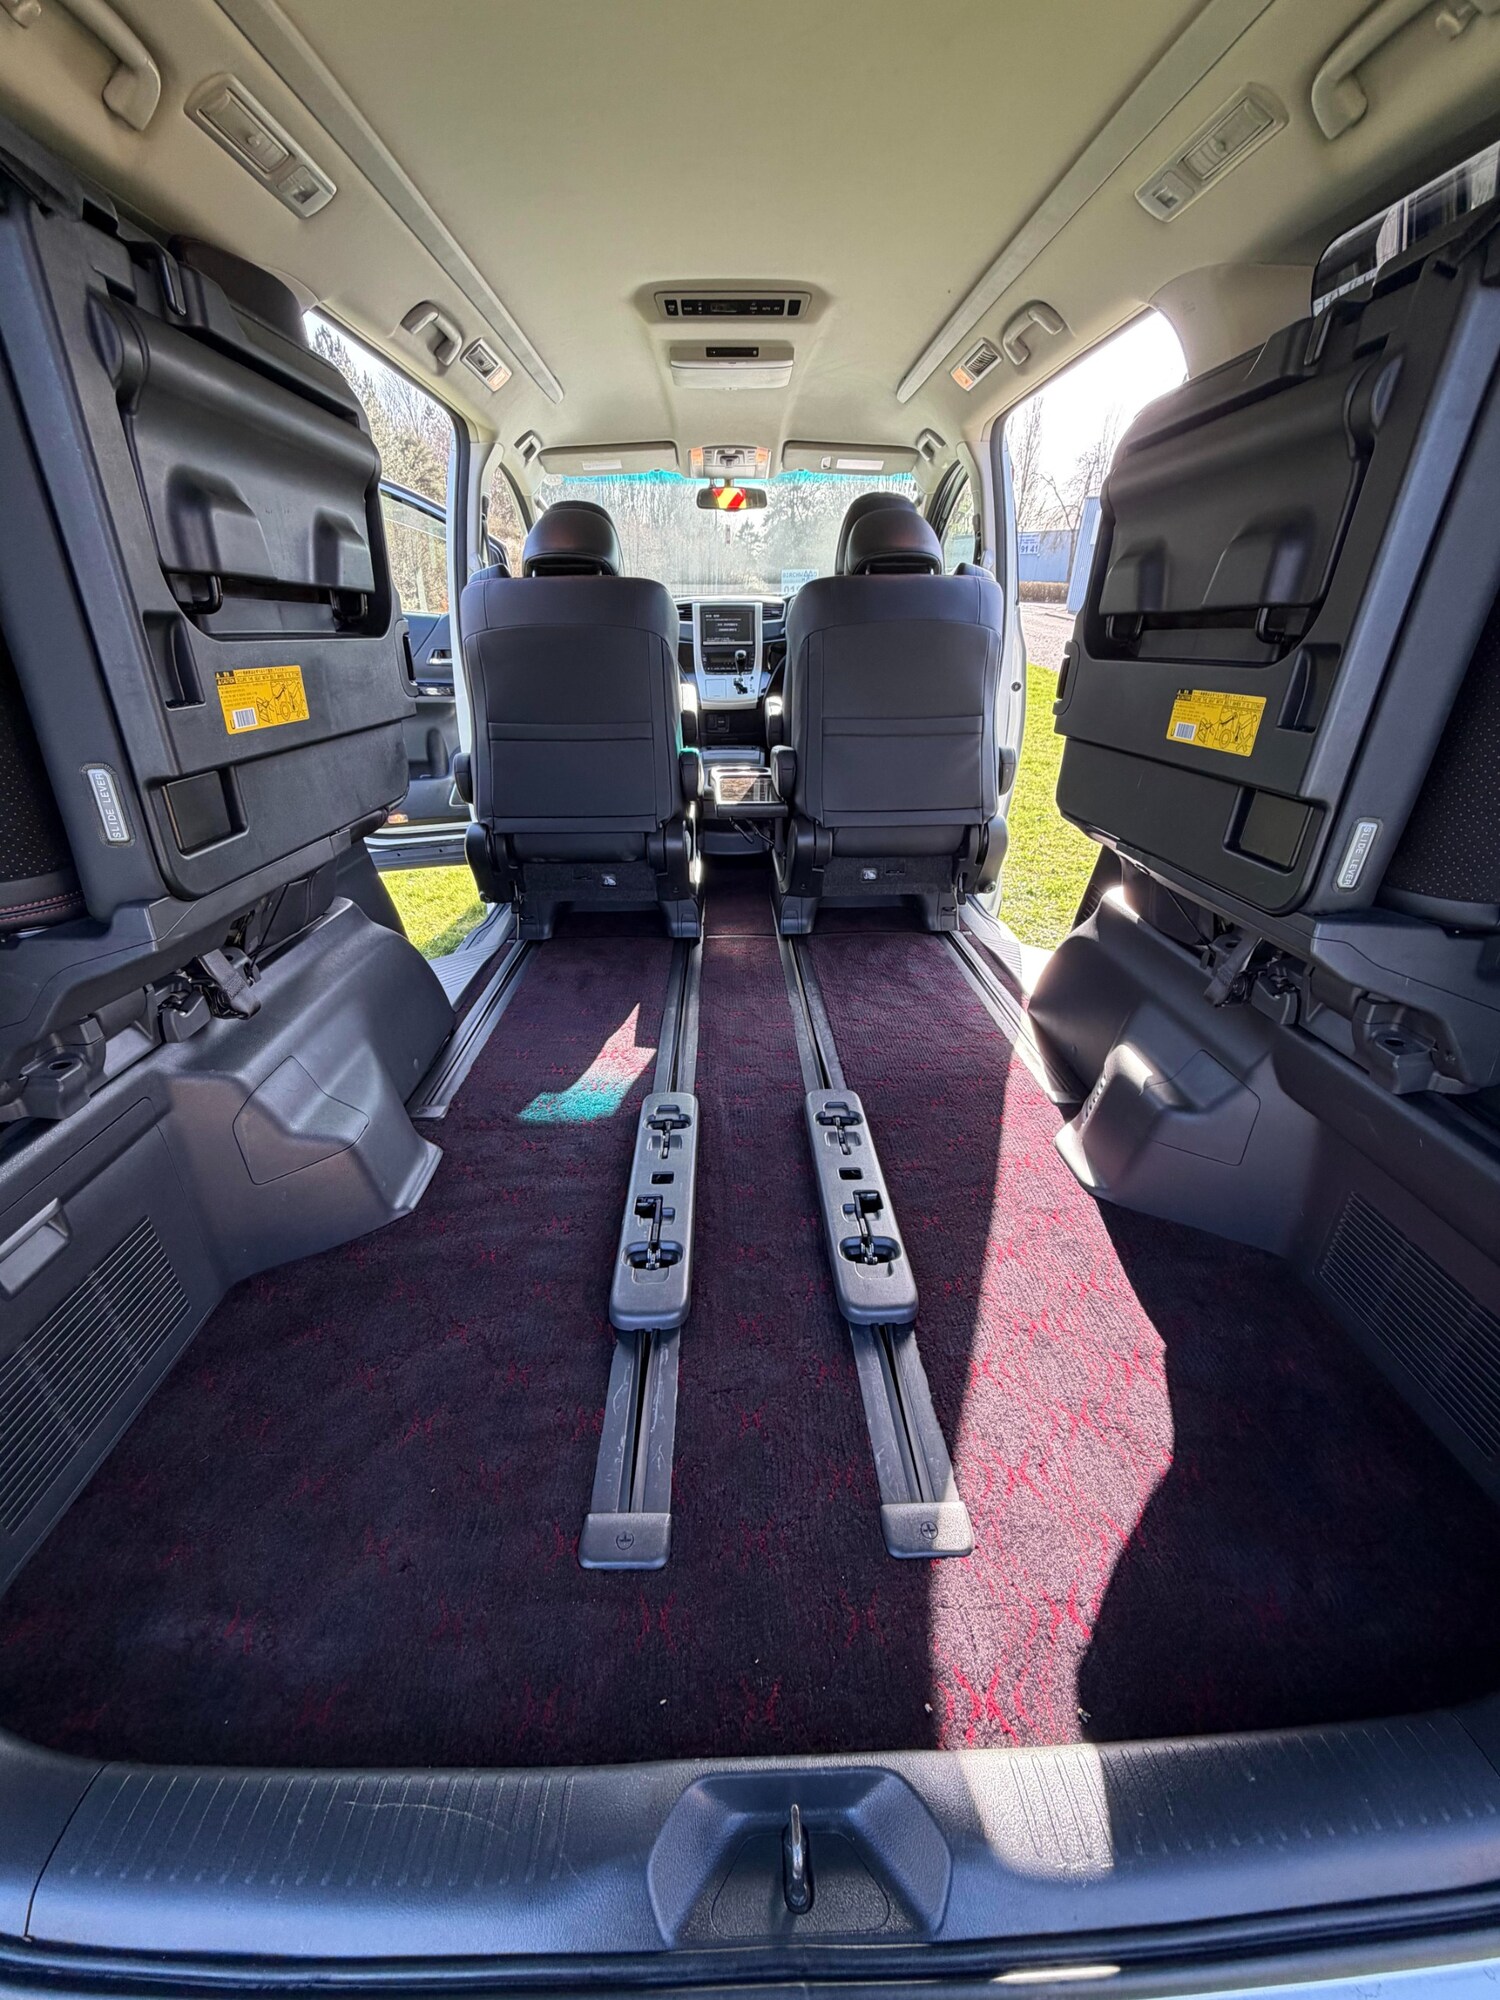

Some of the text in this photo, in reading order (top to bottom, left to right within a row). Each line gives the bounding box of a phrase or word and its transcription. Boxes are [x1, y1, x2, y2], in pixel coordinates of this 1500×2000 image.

[95, 773, 122, 838] SLIDE LEVER
[1343, 825, 1372, 886] SLIDE LEVER
